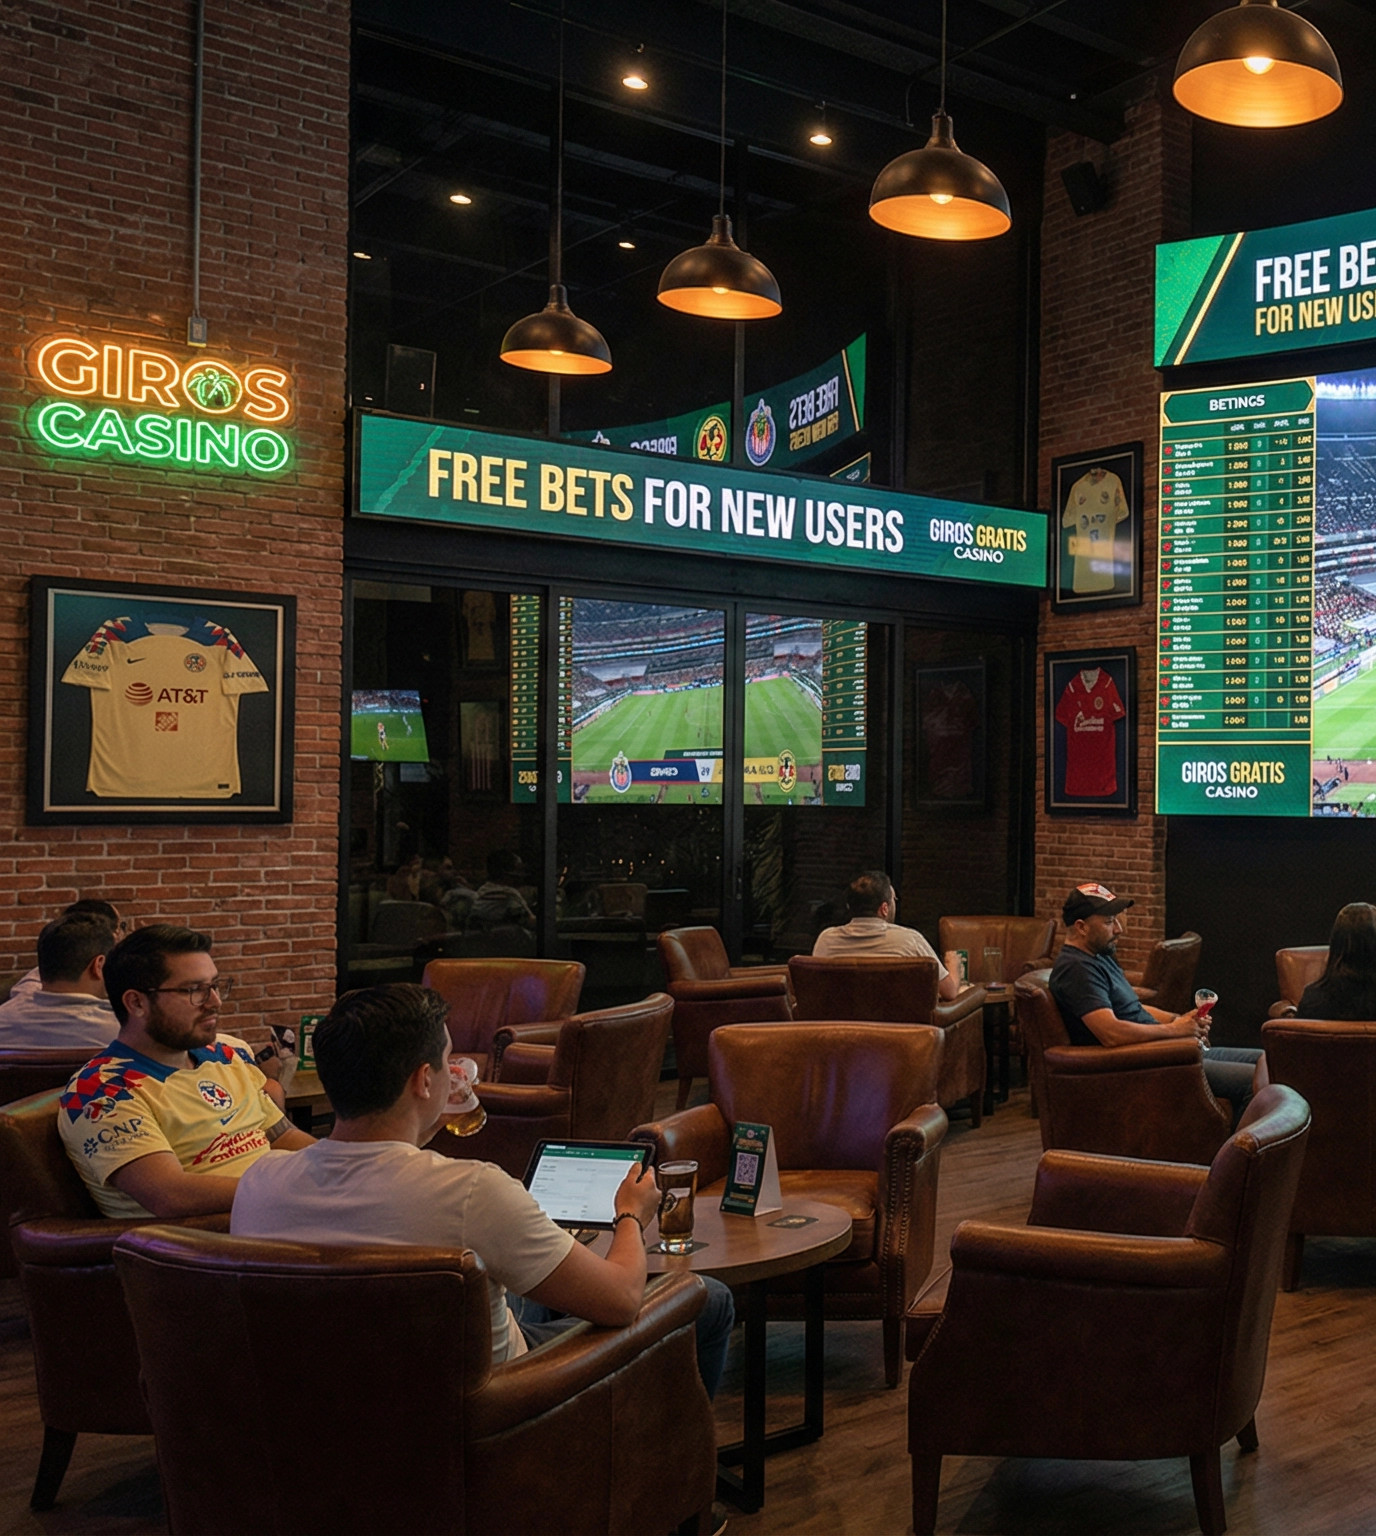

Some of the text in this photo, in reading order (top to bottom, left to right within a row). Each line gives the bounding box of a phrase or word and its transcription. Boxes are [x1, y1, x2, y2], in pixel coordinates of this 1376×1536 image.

[1256, 249, 1330, 302] FREE
[1256, 305, 1293, 335] FOR
[1299, 296, 1343, 329] NEW
[37, 338, 292, 422] GIROS
[37, 402, 290, 473] CASINO
[429, 449, 903, 552] FREE BETS FOR NEW USERS
[930, 519, 1026, 551] GIROS GRATIS
[954, 547, 1003, 563] CASINO
[158, 688, 208, 703] AT&T
[1182, 762, 1284, 783] GIROS GRATIS
[1206, 786, 1257, 798] CASINO
